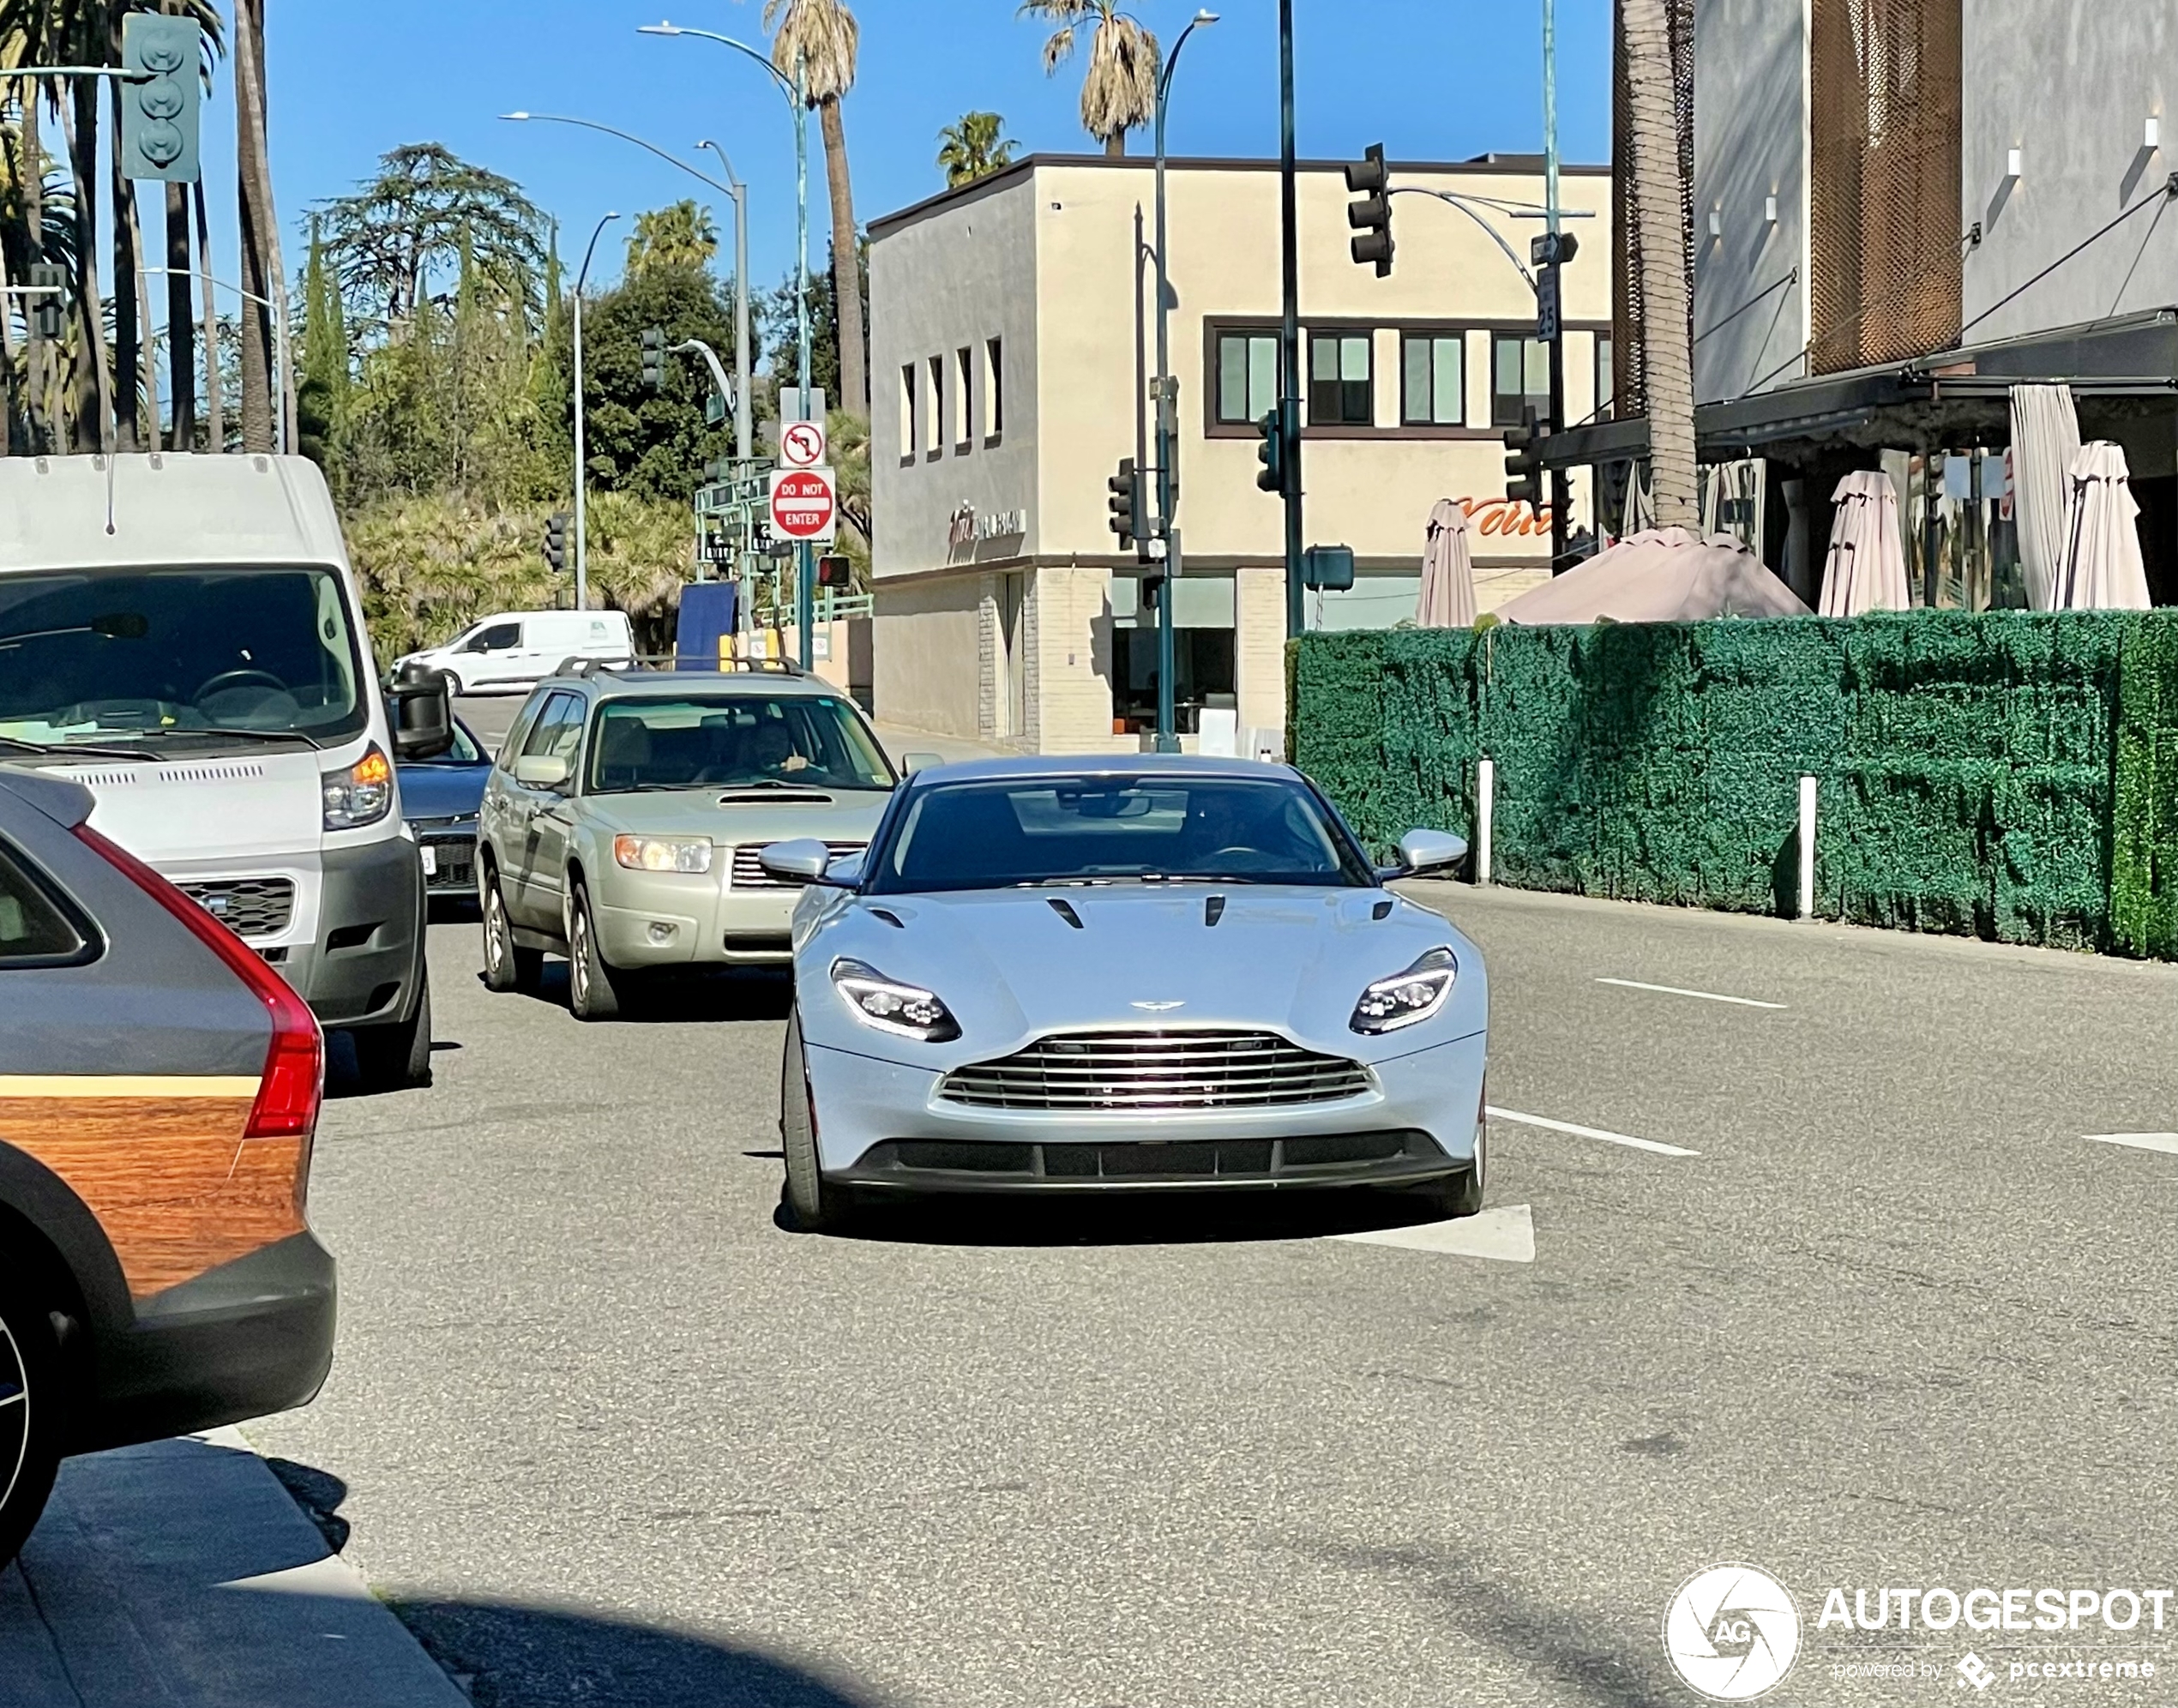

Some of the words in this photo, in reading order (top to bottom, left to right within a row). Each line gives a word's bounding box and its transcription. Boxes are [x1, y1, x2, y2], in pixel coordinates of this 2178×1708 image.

[1540, 306, 1554, 334] 25
[781, 484, 797, 496] DO
[802, 483, 824, 496] NOT
[785, 513, 820, 526] ENTER
